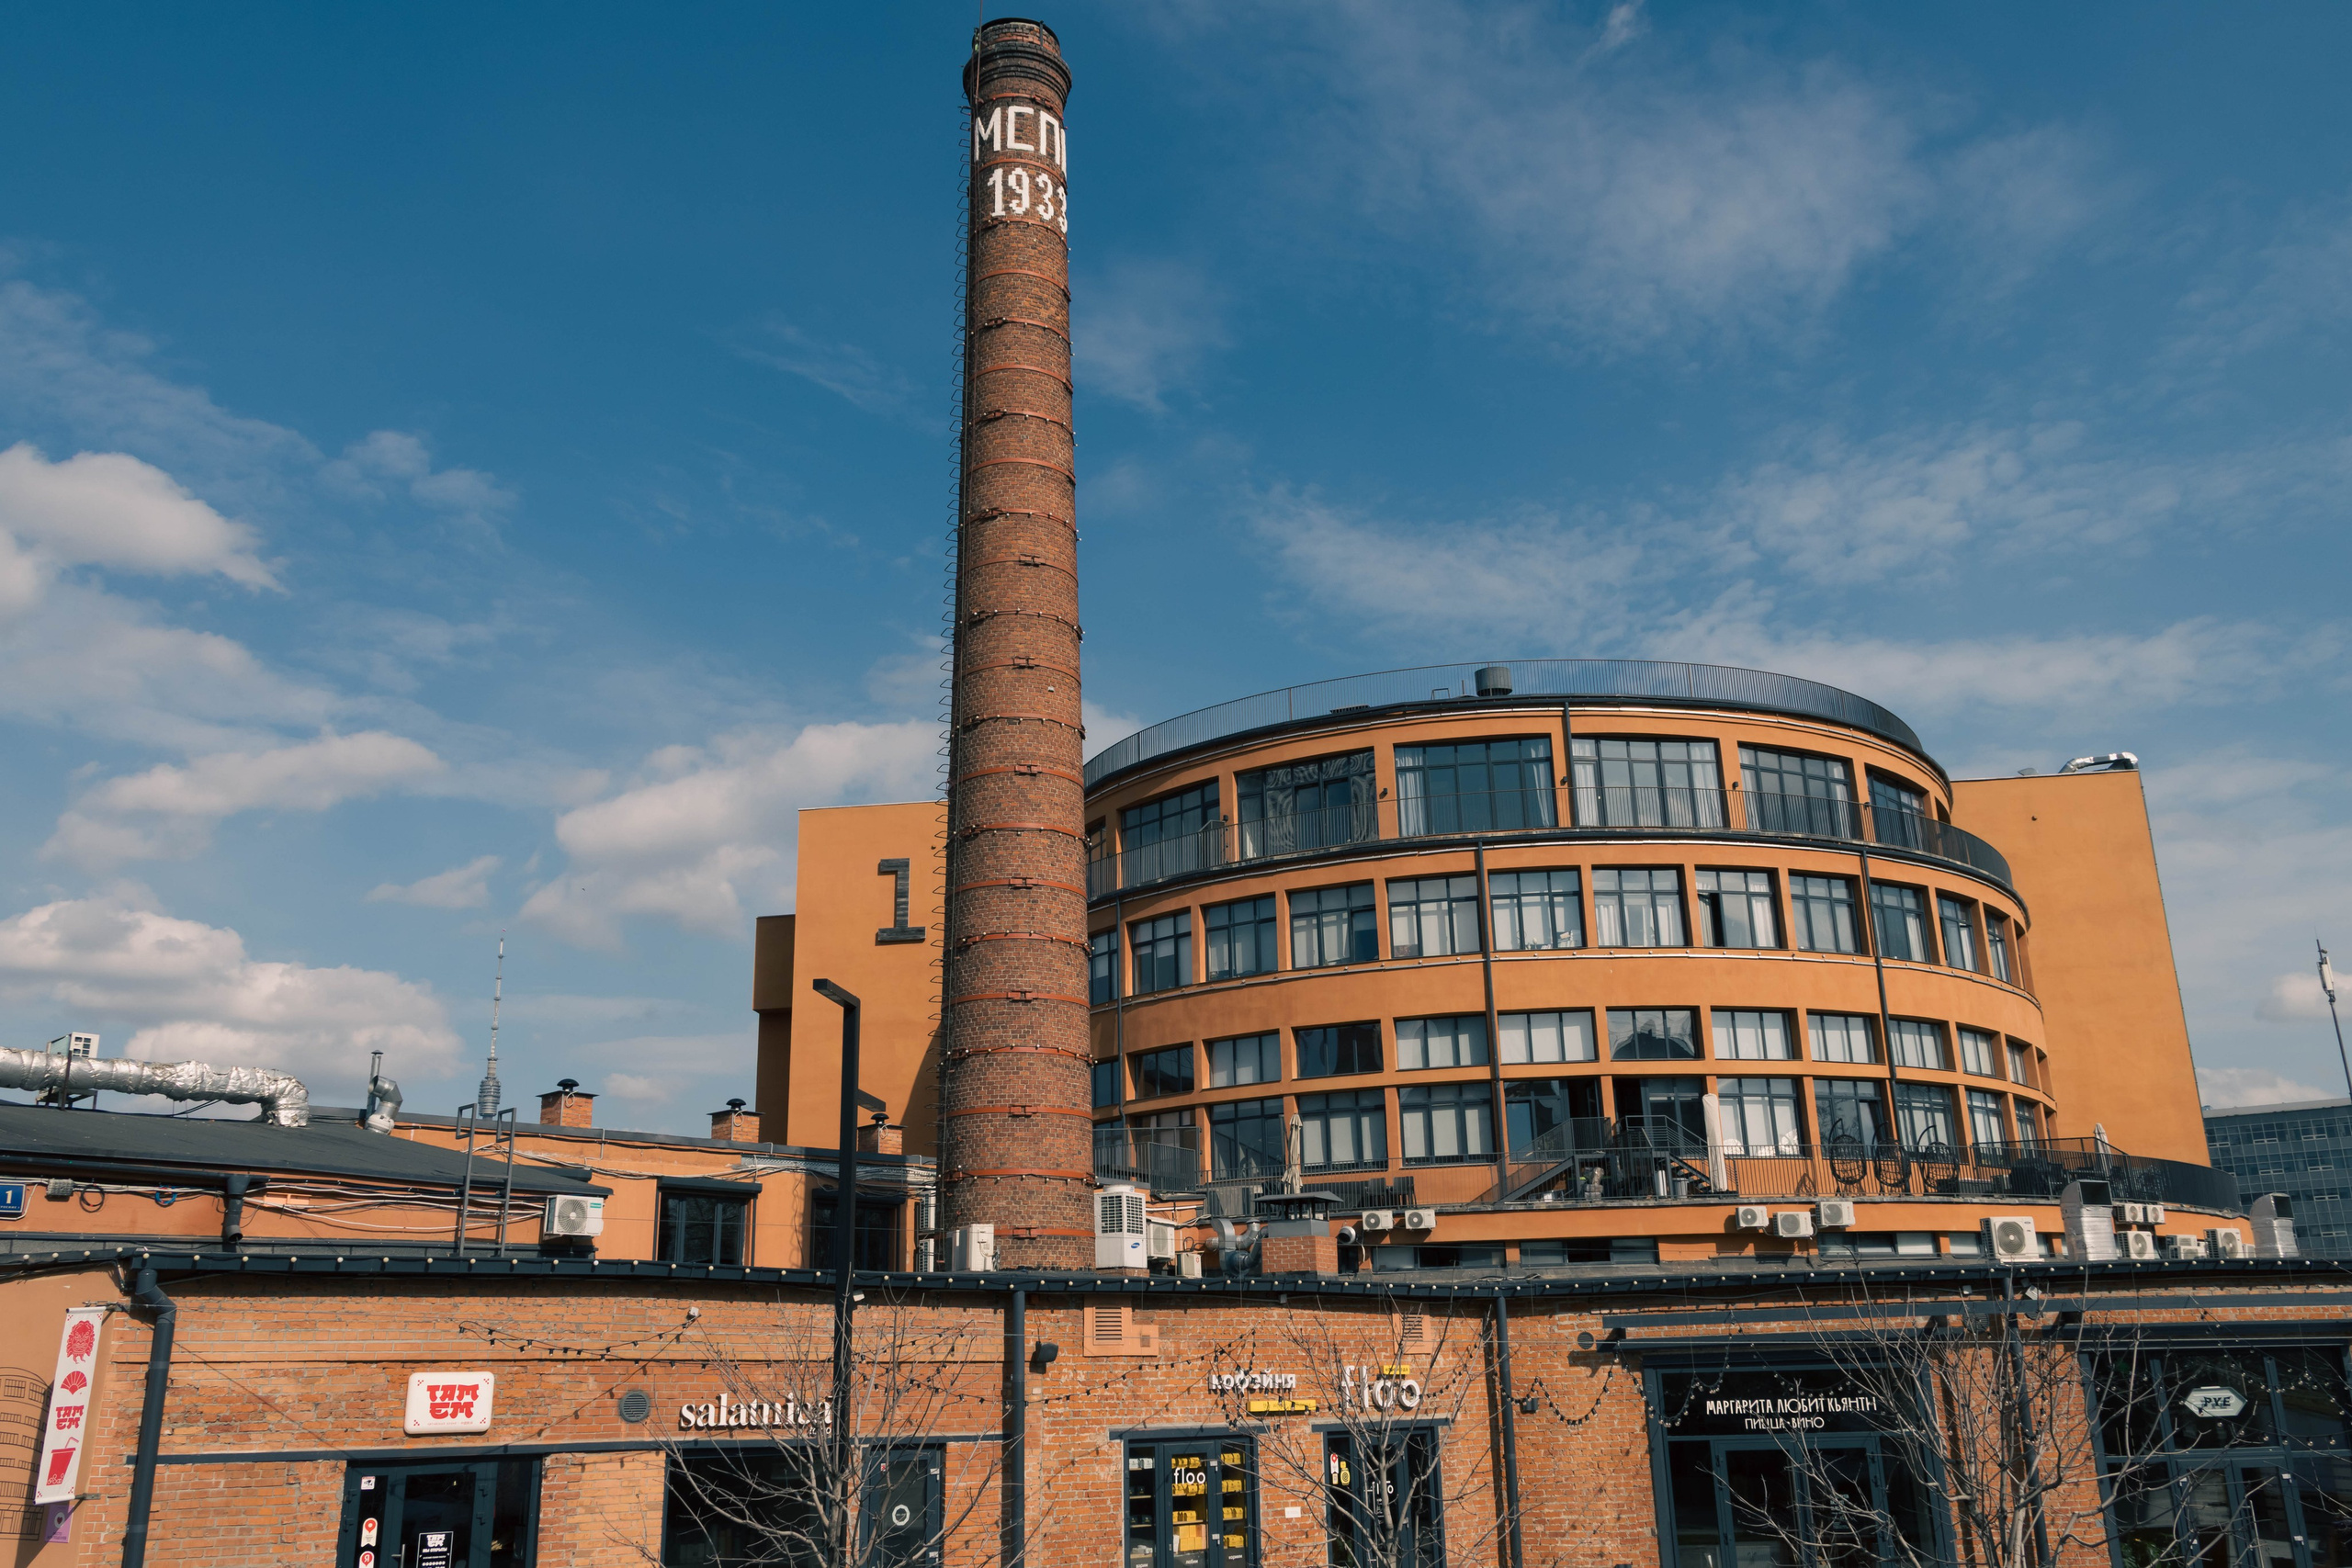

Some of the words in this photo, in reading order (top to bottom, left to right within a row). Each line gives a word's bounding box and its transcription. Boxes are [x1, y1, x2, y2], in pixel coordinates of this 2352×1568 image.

[877, 857, 926, 942] 1
[6, 1190, 13, 1204] 1
[1706, 1399, 1774, 1415] МАРГАРИТА
[1777, 1398, 1825, 1413] ЛЮБИТ
[2204, 1396, 2231, 1406] PYE
[1792, 1416, 1825, 1428] ВИНО
[1173, 1467, 1206, 1484] floo
